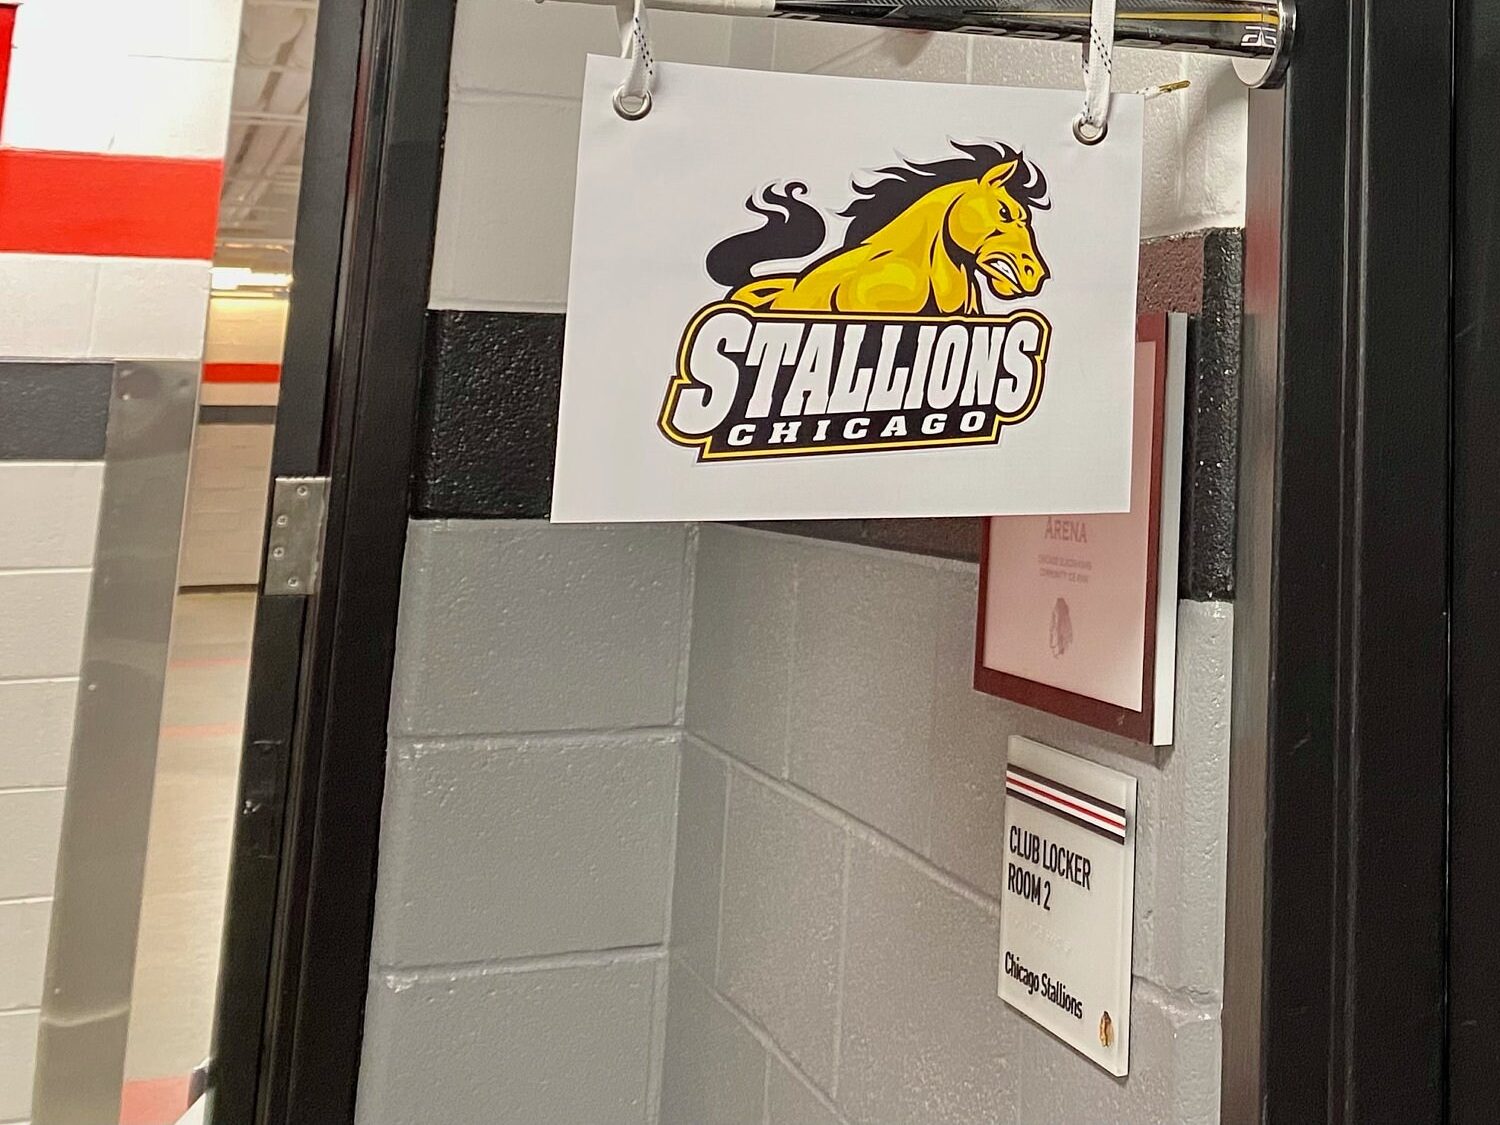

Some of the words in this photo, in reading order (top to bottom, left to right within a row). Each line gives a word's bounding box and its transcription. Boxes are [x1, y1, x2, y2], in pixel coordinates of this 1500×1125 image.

[671, 312, 1040, 435] STALLIONS
[726, 410, 987, 447] CHICAGO
[1044, 516, 1088, 543] ARENA
[1007, 862, 1042, 906] ROOM
[1043, 880, 1051, 911] 2
[1009, 825, 1040, 864] CLUB
[1042, 839, 1091, 891] LOCKER
[1004, 951, 1040, 995] Chicago
[1041, 973, 1083, 1019] Stallions
